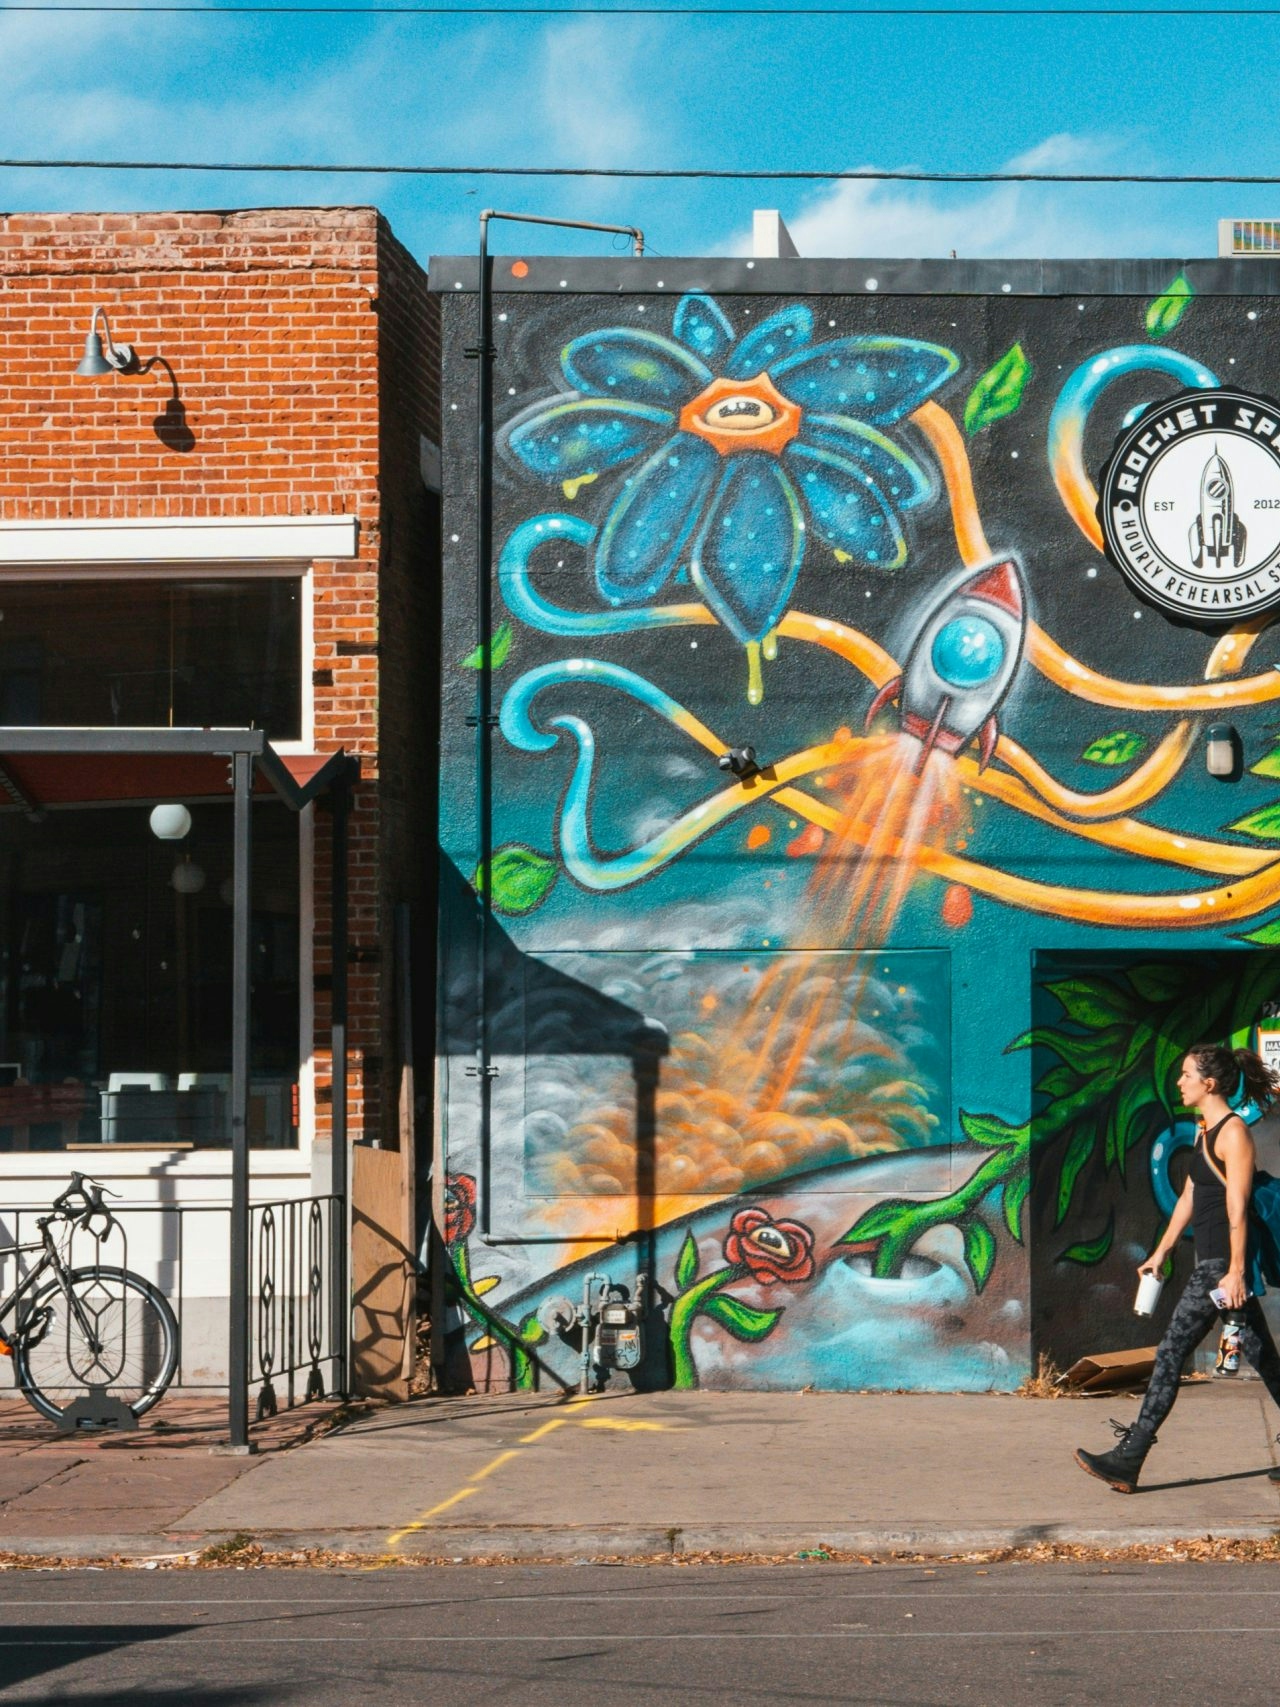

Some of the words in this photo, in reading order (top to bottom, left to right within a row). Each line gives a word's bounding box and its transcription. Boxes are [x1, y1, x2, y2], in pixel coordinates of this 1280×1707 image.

[1117, 404, 1218, 494] ROCKET
[1154, 501, 1175, 511] EST
[1253, 499, 1280, 510] 2012
[1120, 519, 1164, 580] HOURLY
[1164, 576, 1266, 604] REHEARSAL
